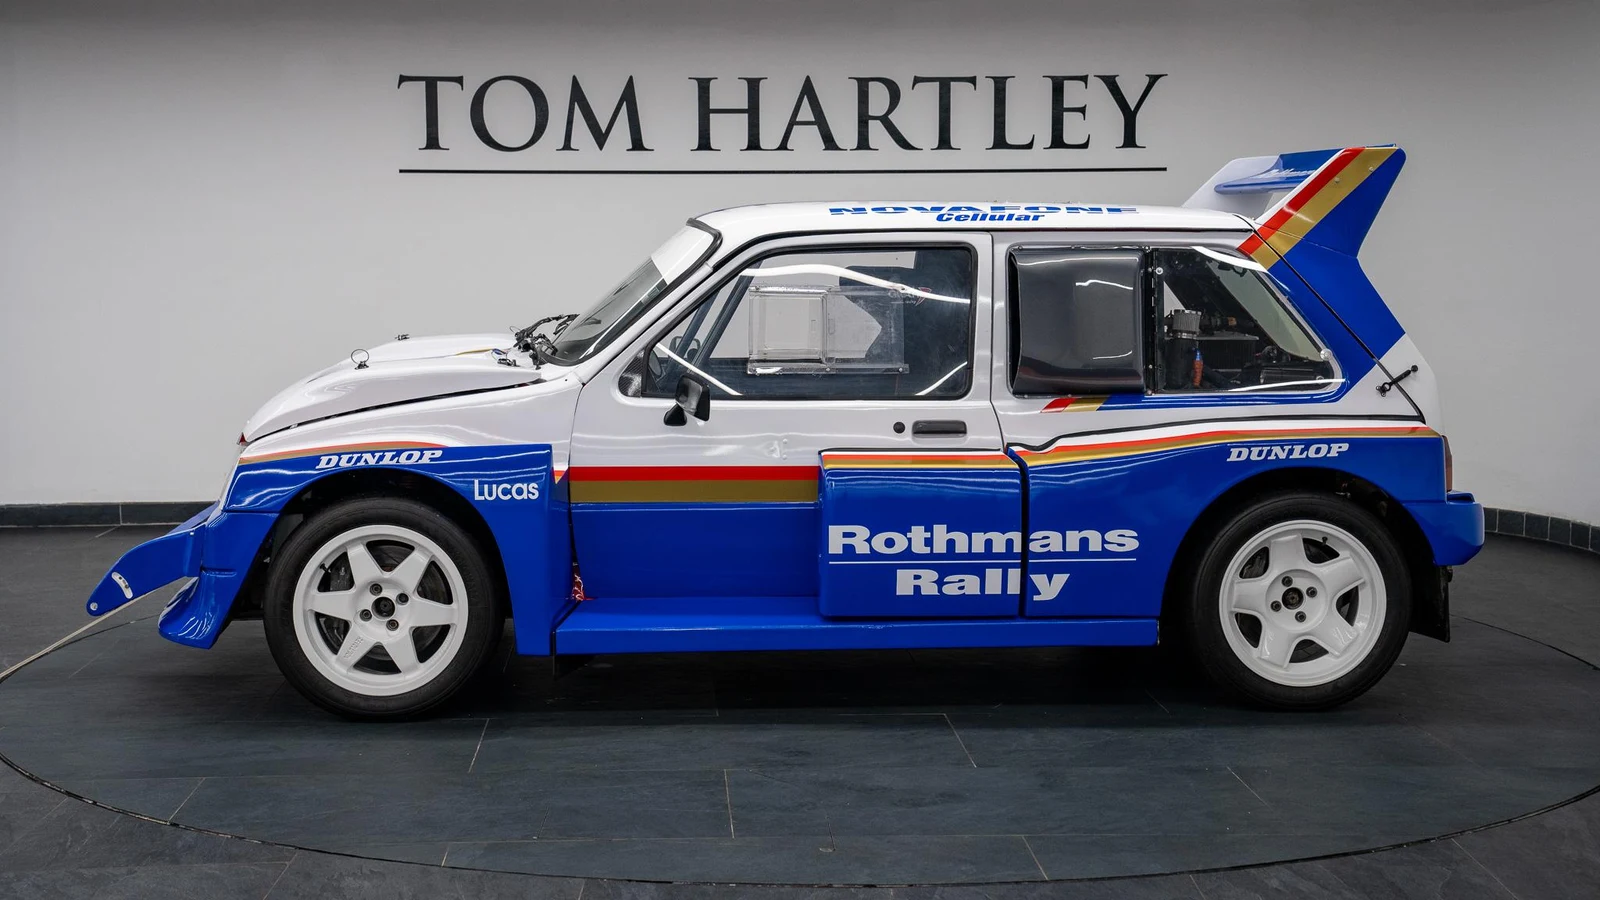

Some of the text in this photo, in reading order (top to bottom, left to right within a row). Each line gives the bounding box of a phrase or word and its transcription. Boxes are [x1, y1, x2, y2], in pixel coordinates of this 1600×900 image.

[398, 73, 1168, 154] TOM HARTLEY
[828, 205, 1139, 215] NOVAFONE
[935, 213, 1045, 222] Cellular
[315, 449, 443, 470] DUNLOP
[1226, 442, 1350, 462] DUNLOP
[473, 478, 540, 501] Lucas
[828, 524, 1140, 555] Rothmans
[895, 568, 1071, 602] Rally
